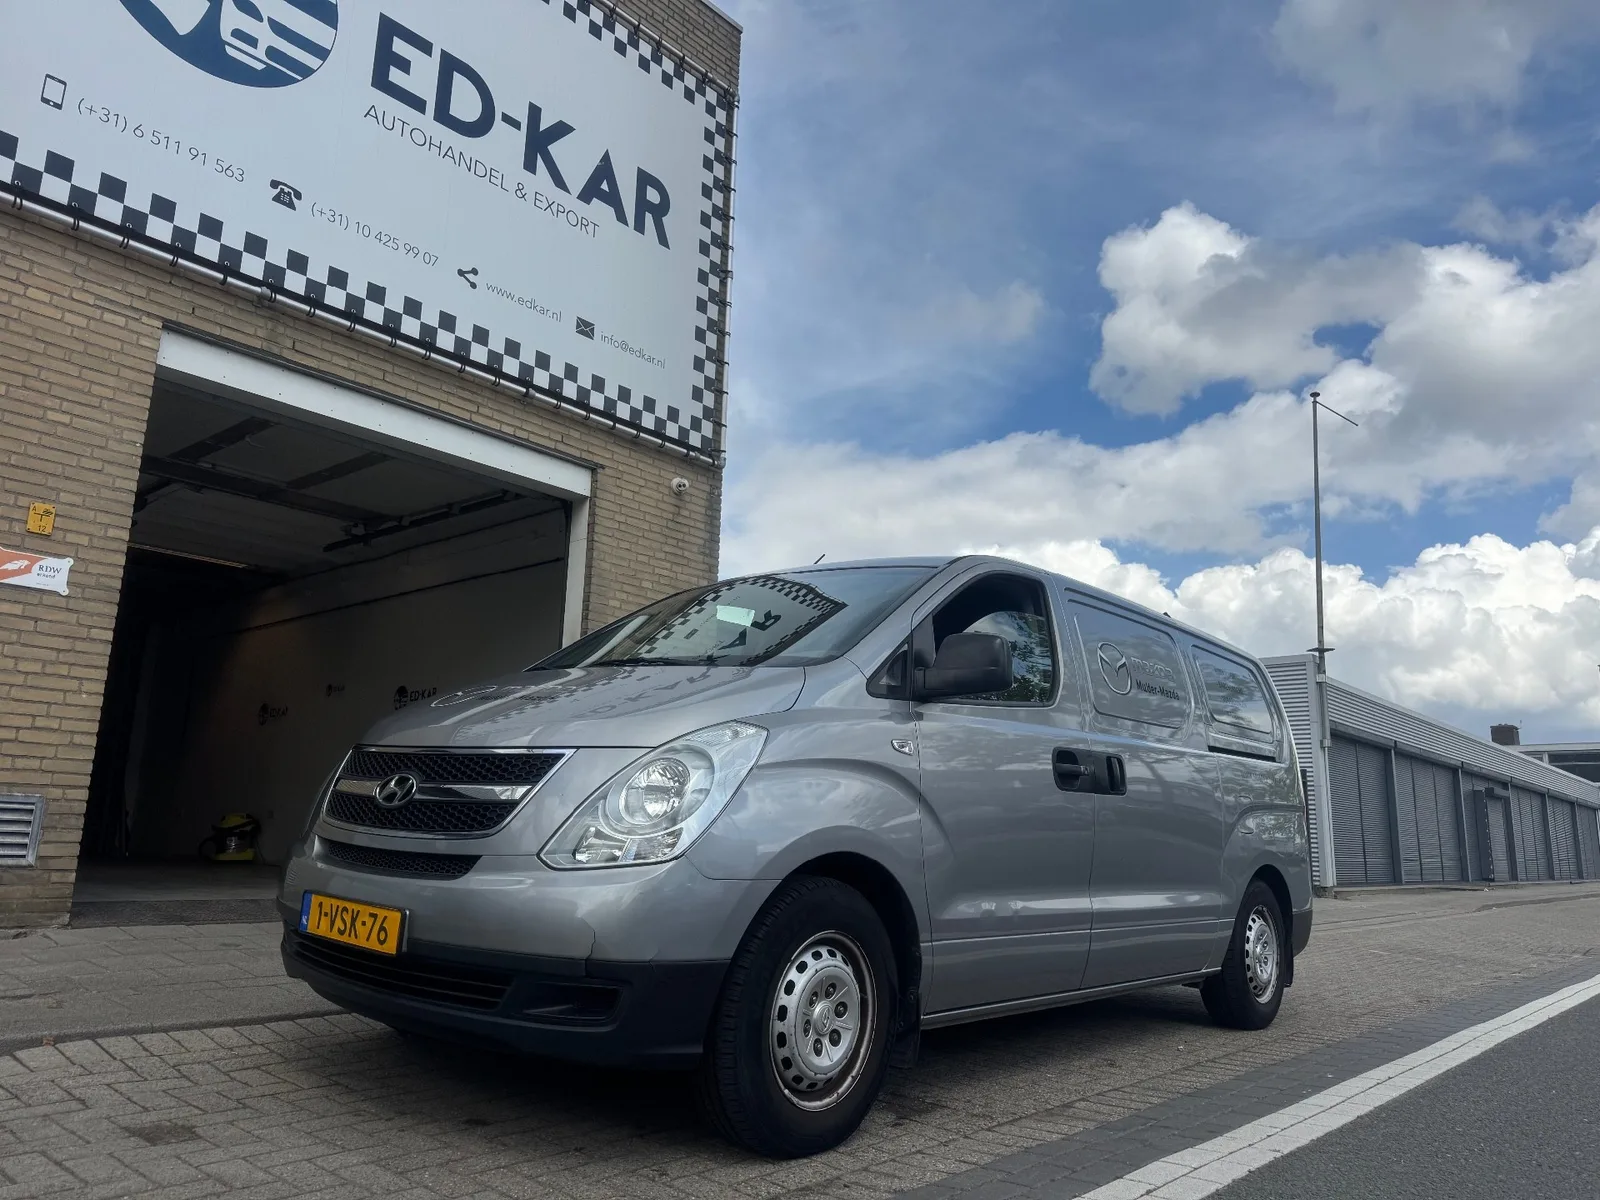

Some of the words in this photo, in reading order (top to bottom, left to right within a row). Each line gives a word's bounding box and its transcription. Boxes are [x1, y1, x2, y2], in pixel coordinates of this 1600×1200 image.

[77, 98, 128, 133] (+31)
[133, 124, 145, 139] 6
[150, 130, 181, 155] 511
[188, 147, 207, 167] 91
[214, 158, 245, 183] 563
[370, 11, 671, 251] ED-KAR
[364, 104, 510, 193] AUTOHANDEL
[514, 182, 528, 202] &
[533, 190, 600, 239] EXPORT
[311, 202, 349, 231] (+31)
[355, 221, 371, 238] 10
[374, 230, 400, 251] 425
[403, 241, 420, 259] 99
[422, 251, 439, 267] 07
[486, 282, 562, 323] www.edkar.nl
[600, 331, 666, 370] info@edkar.nl
[38, 564, 62, 575] RDW
[1135, 678, 1180, 701] Mulder-Mazda
[316, 901, 388, 946] 1-VSK-76
